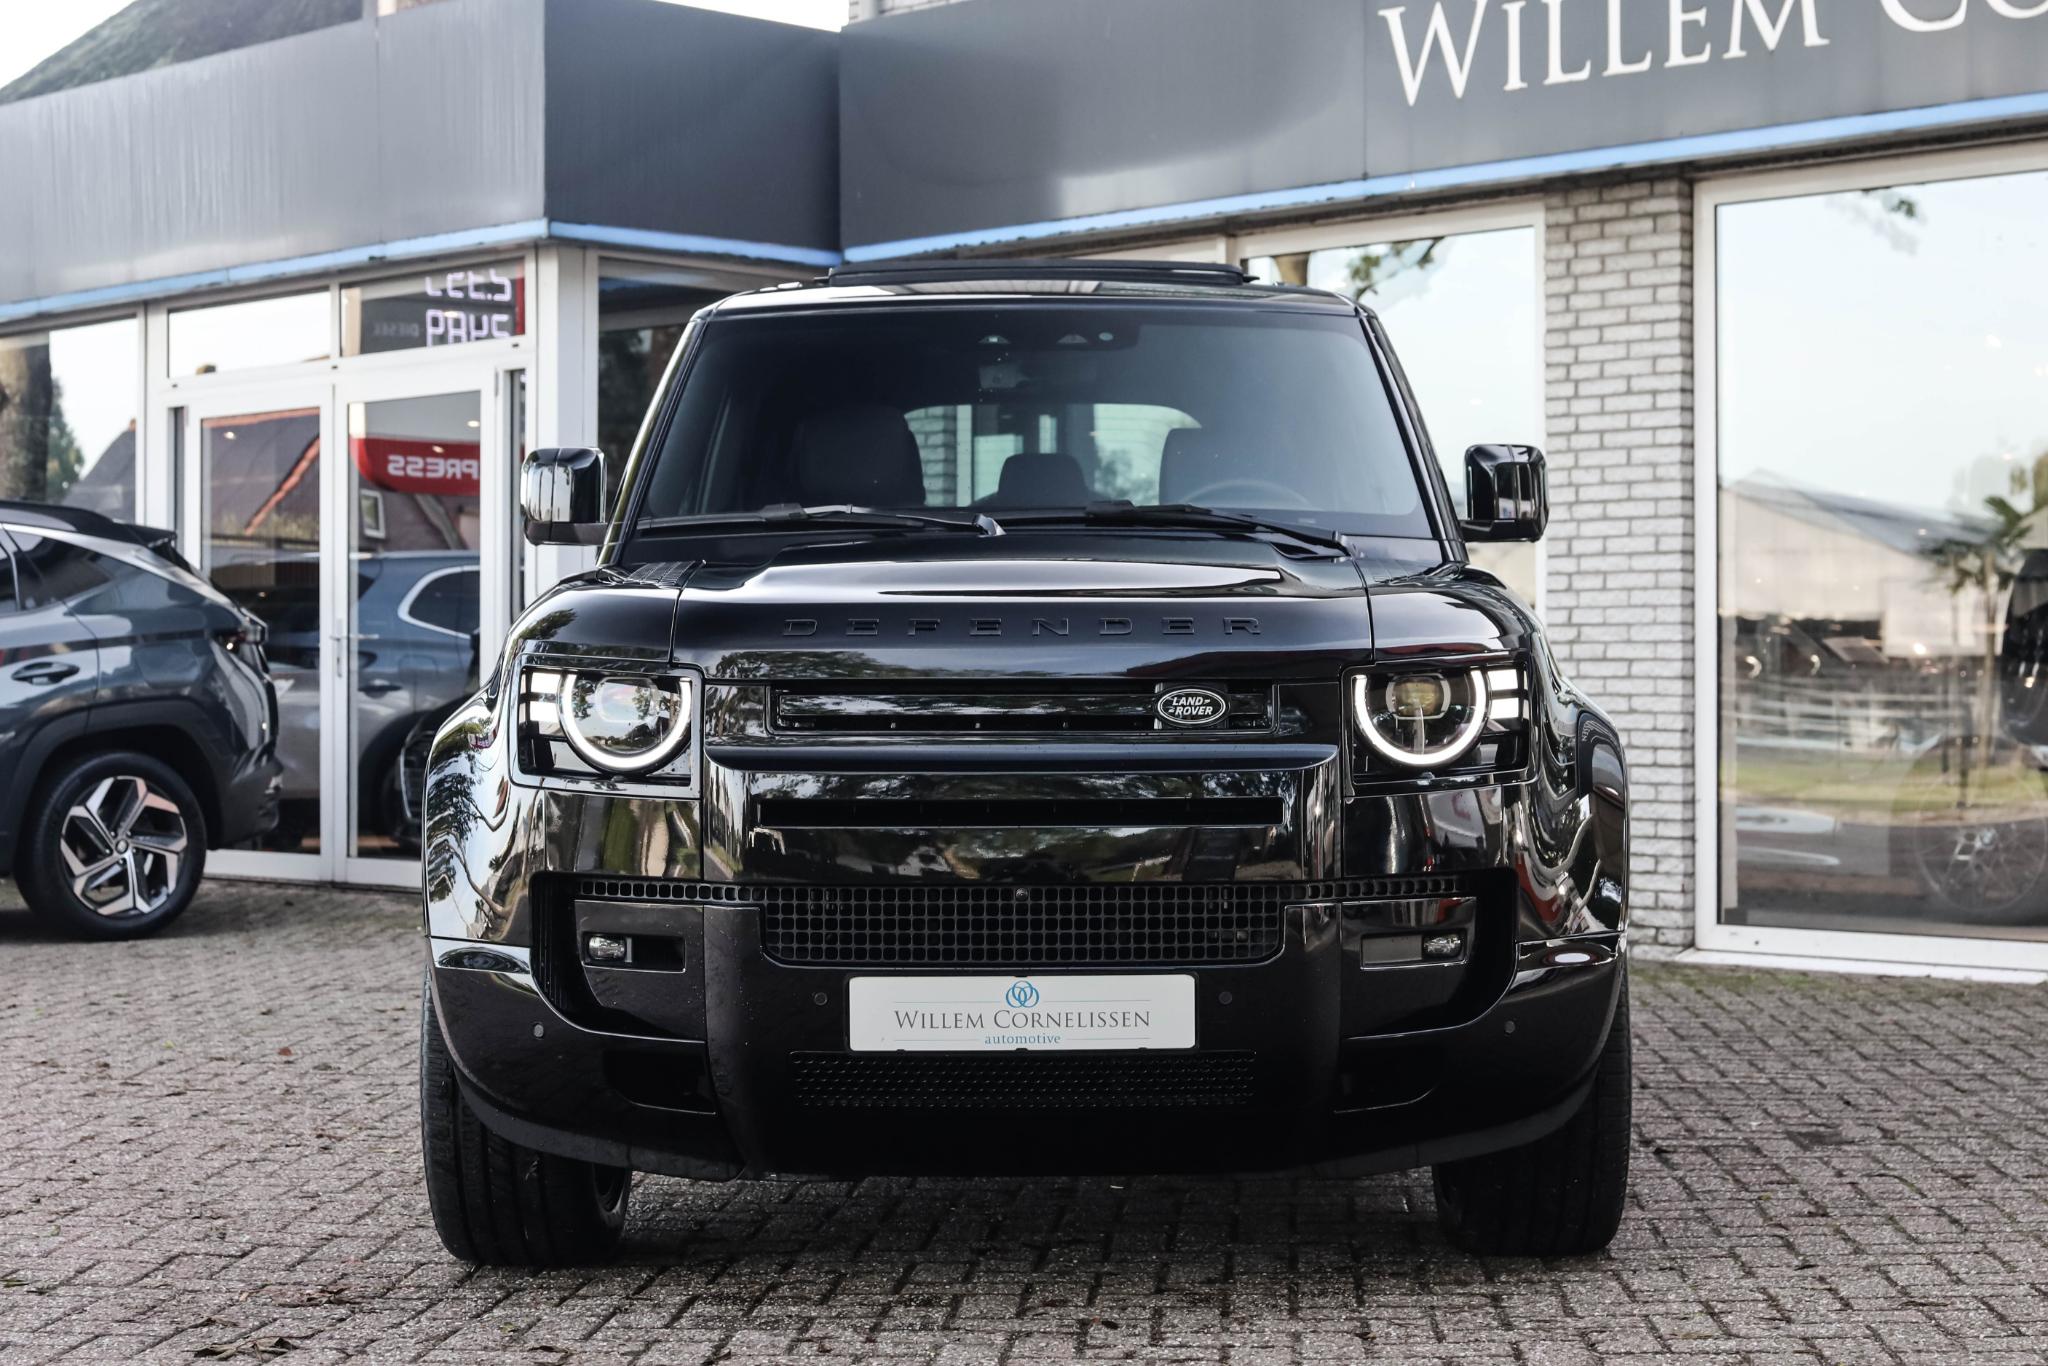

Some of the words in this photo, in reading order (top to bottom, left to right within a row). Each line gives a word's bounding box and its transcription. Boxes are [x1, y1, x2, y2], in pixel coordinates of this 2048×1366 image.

[1378, 0, 1830, 106] WILLEM
[783, 617, 1262, 636] DEFENDER
[1172, 697, 1204, 706] LAND
[1175, 706, 1213, 716] ROVER
[894, 1010, 985, 1029] WILLEM
[993, 1009, 1151, 1029] CORNELISSEN
[984, 1032, 1061, 1045] automotive
